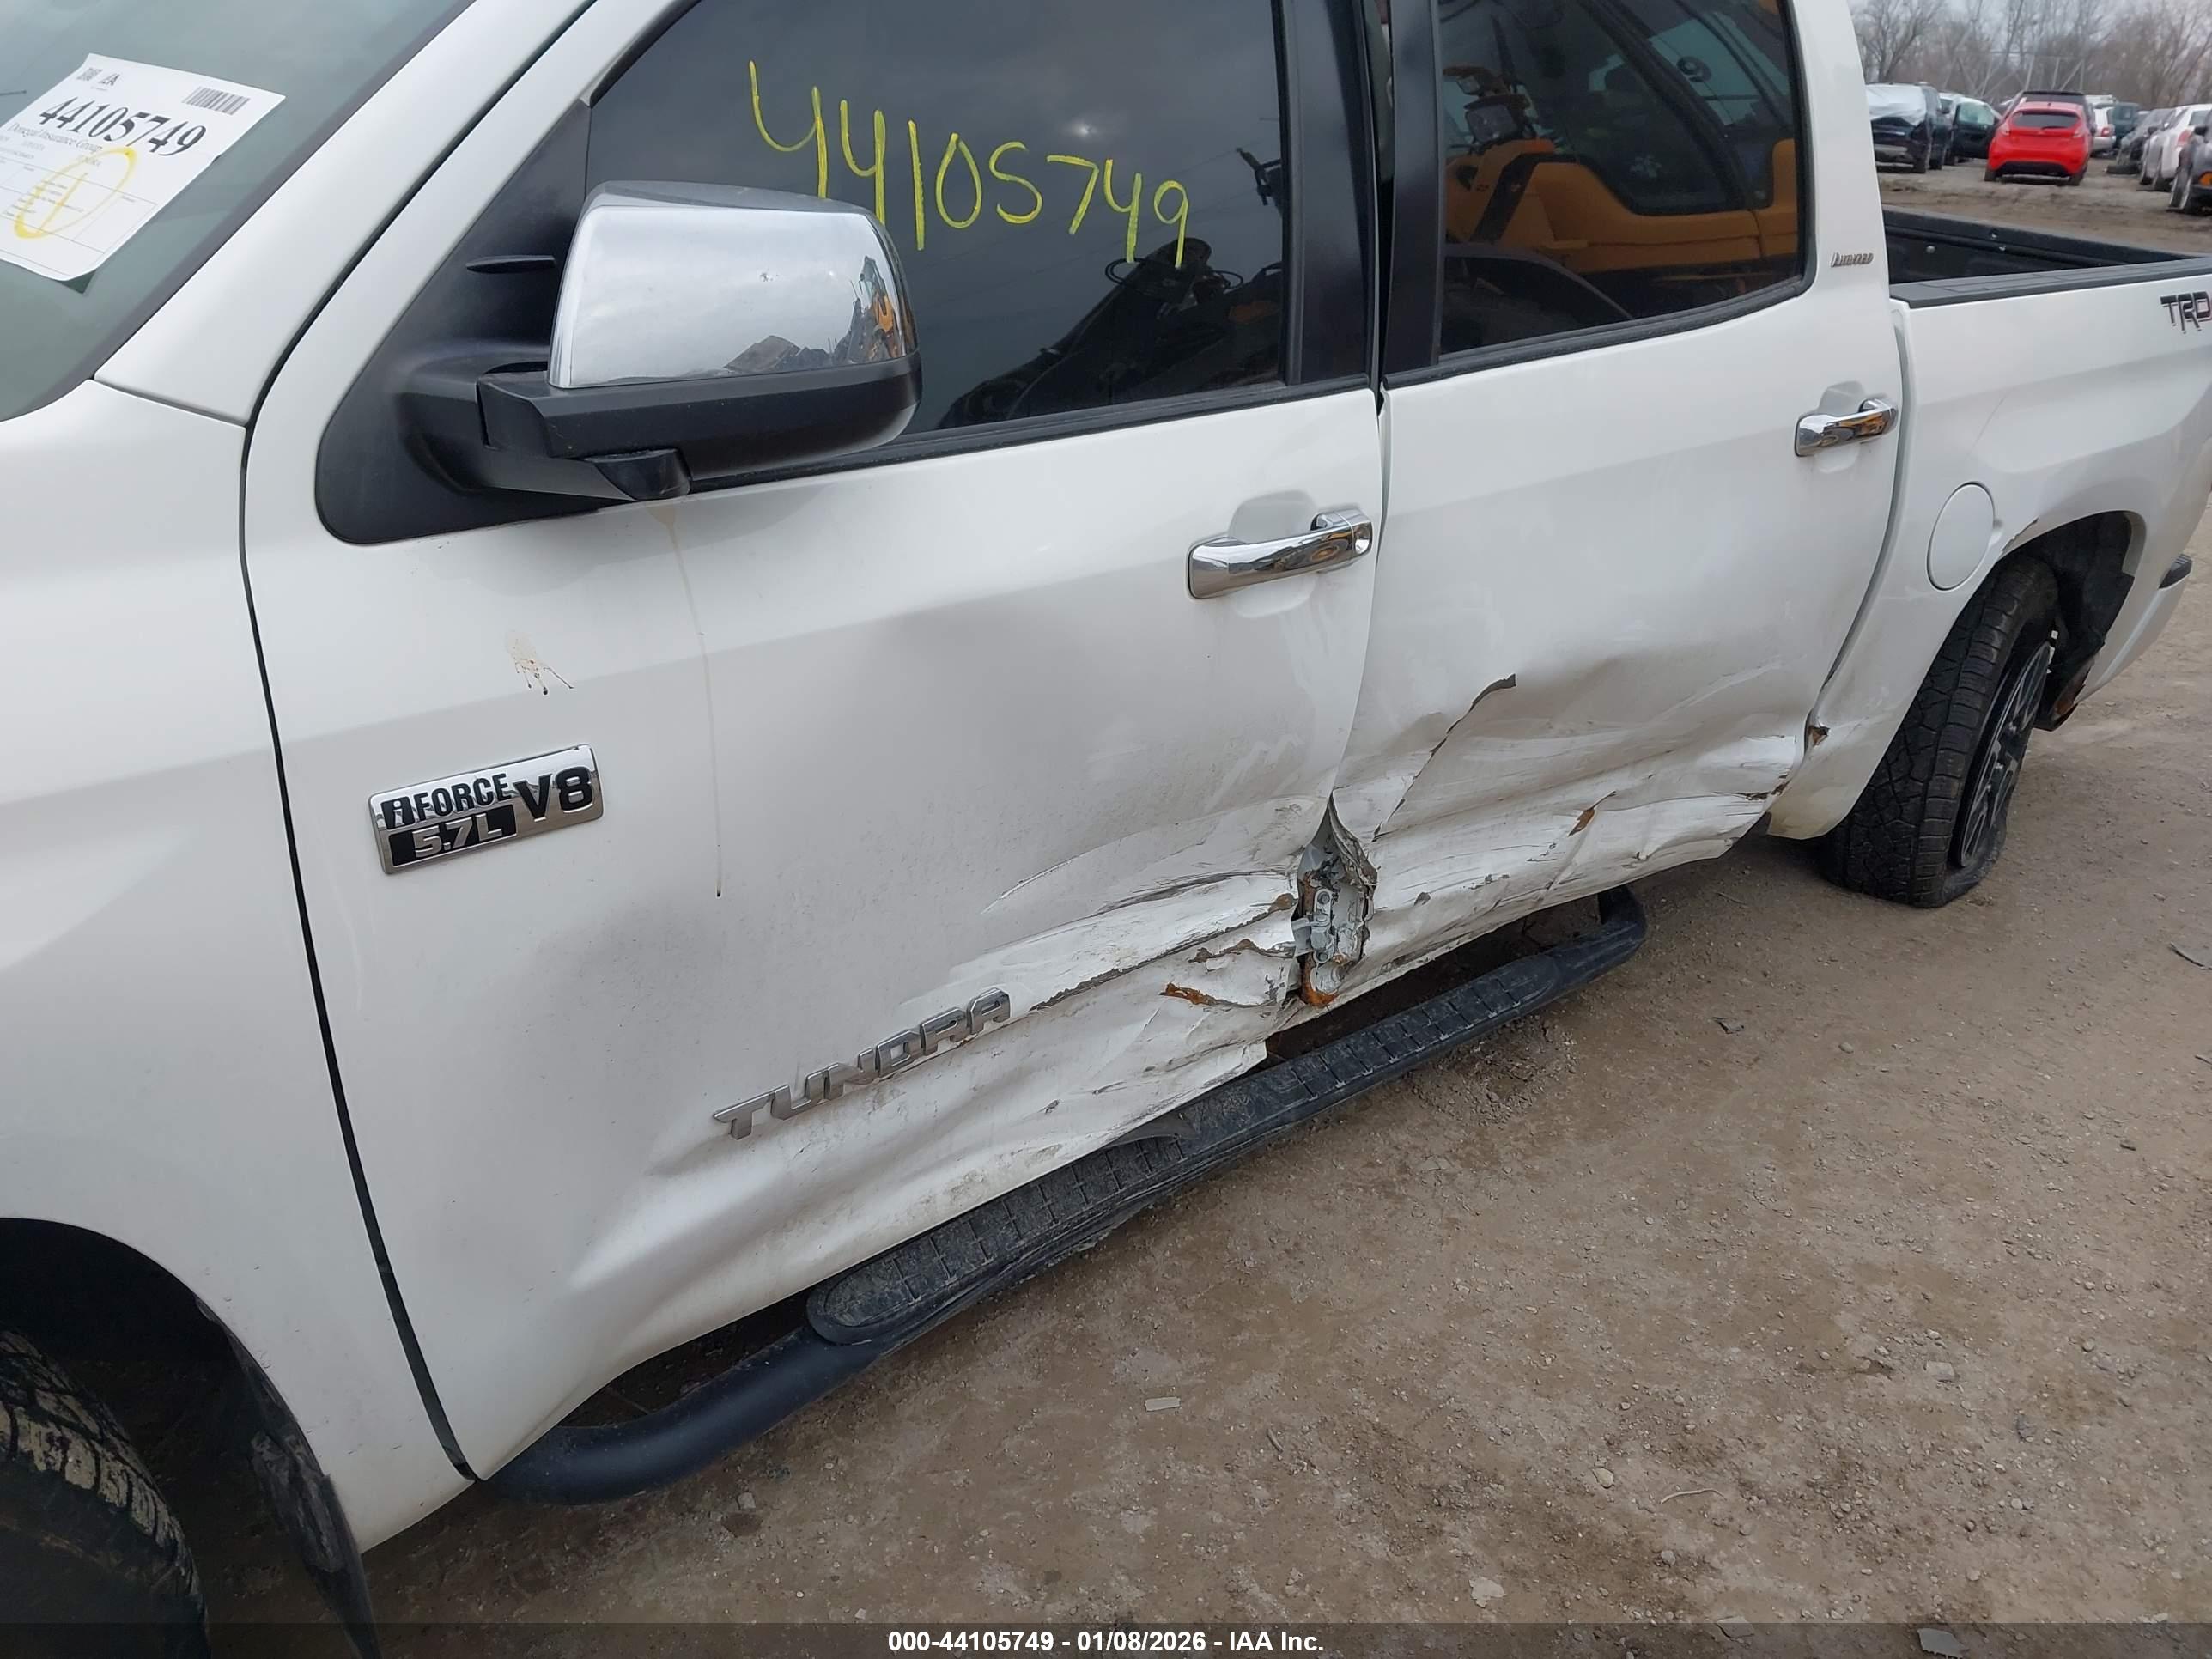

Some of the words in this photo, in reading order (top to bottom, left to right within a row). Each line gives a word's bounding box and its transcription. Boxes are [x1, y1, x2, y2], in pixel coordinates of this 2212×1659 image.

[39, 95, 208, 157] 44105749
[748, 59, 1190, 269] 44105749
[2160, 290, 2212, 334] TRD
[514, 766, 594, 823] V8
[412, 812, 504, 859] 5.7L
[714, 987, 1011, 1140] TUNDRA
